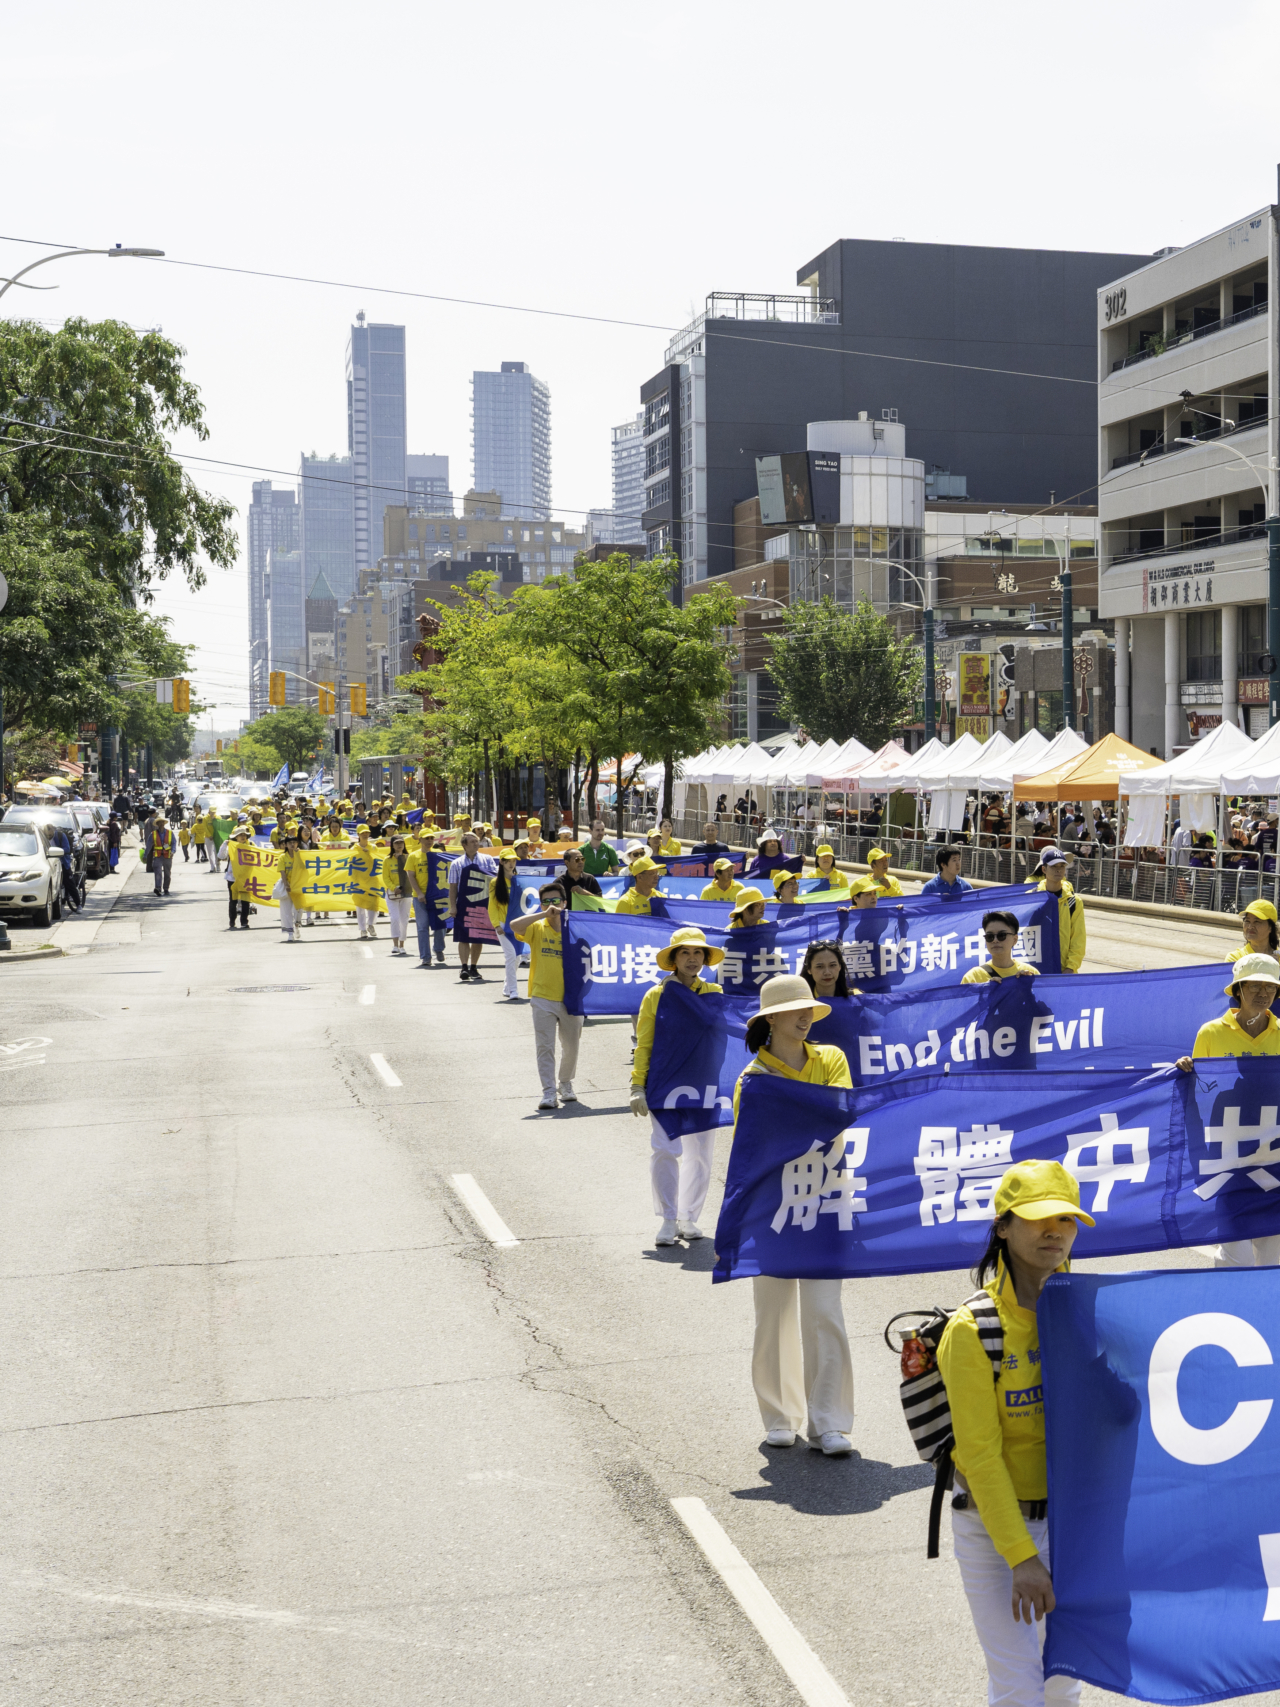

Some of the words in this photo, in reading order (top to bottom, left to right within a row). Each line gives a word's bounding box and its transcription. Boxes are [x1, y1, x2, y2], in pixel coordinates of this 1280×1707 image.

[1105, 287, 1126, 321] 302
[581, 924, 1042, 985] 迎接有共黨的新中國
[859, 1030, 941, 1075] End
[950, 1021, 1016, 1063] the
[1030, 1008, 1104, 1054] Evil
